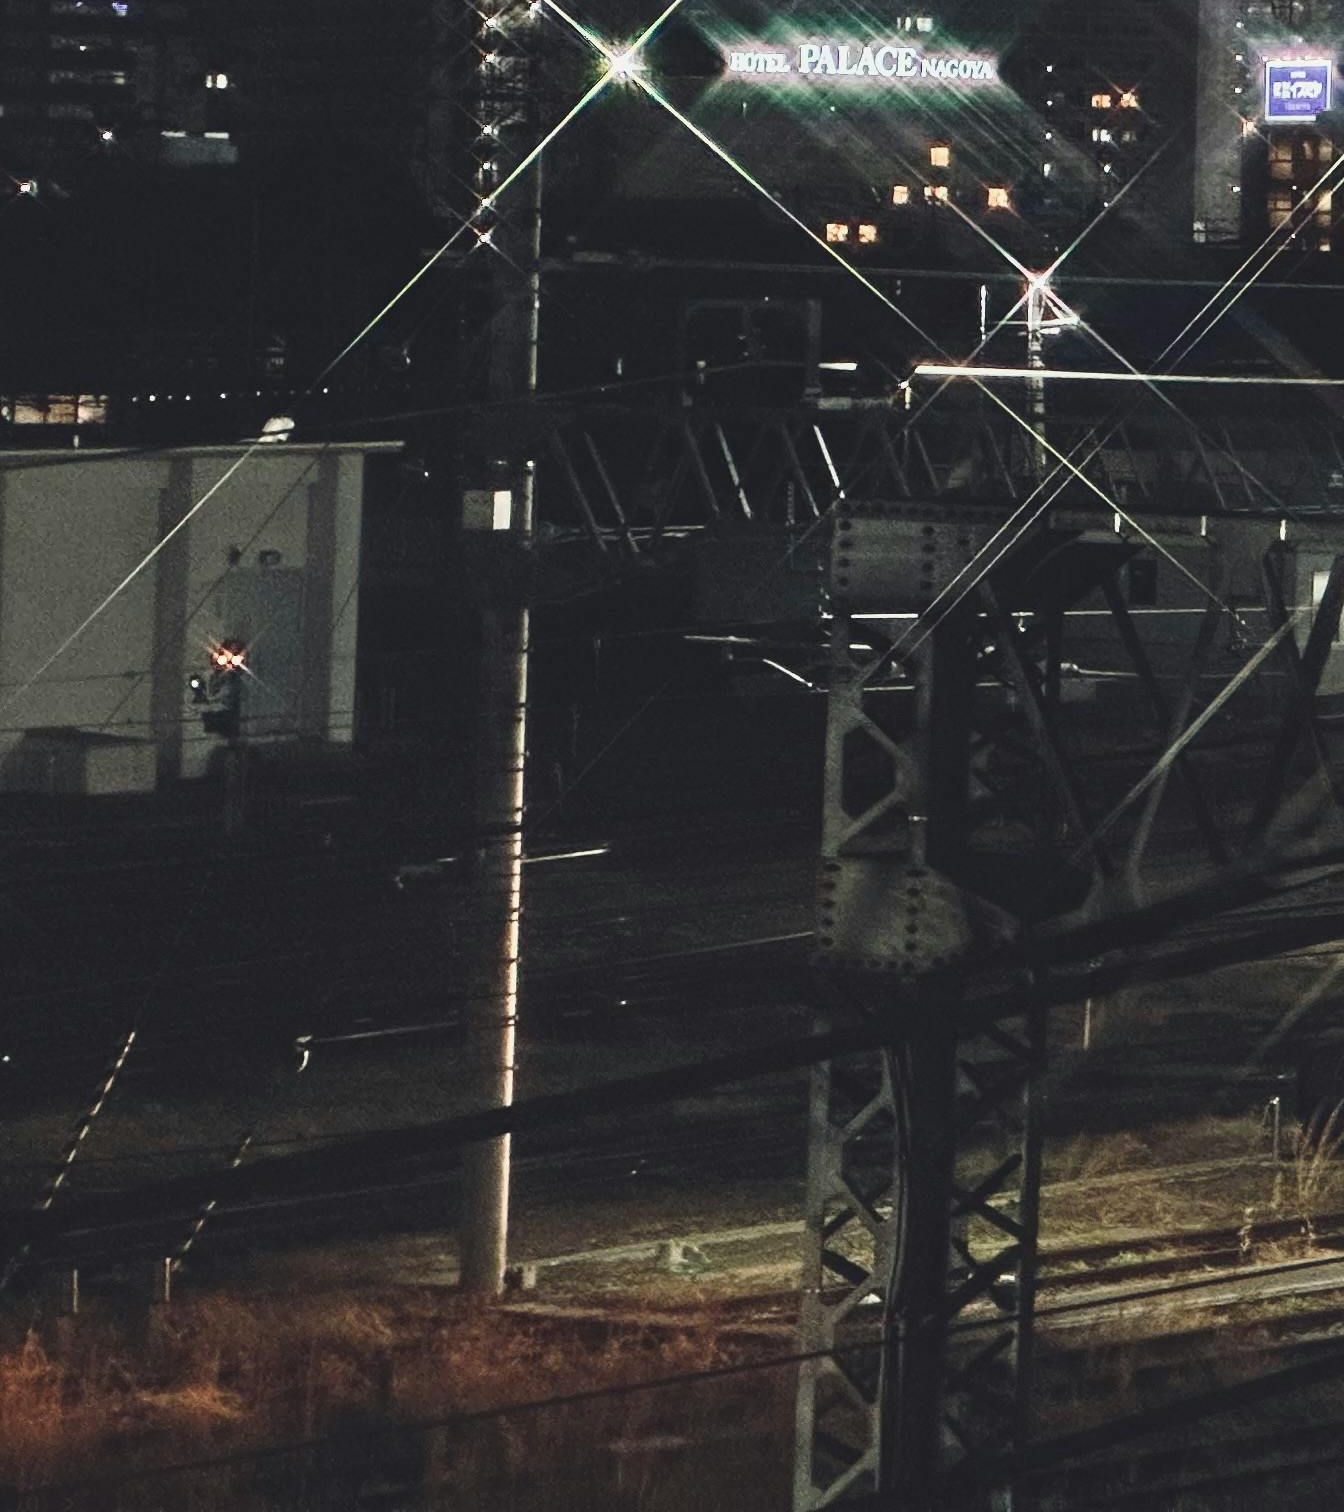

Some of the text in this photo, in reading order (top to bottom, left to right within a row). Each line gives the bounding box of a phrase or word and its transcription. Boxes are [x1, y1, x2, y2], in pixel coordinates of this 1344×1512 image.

[729, 43, 994, 80] HOTEL PALACE NAGOYA
